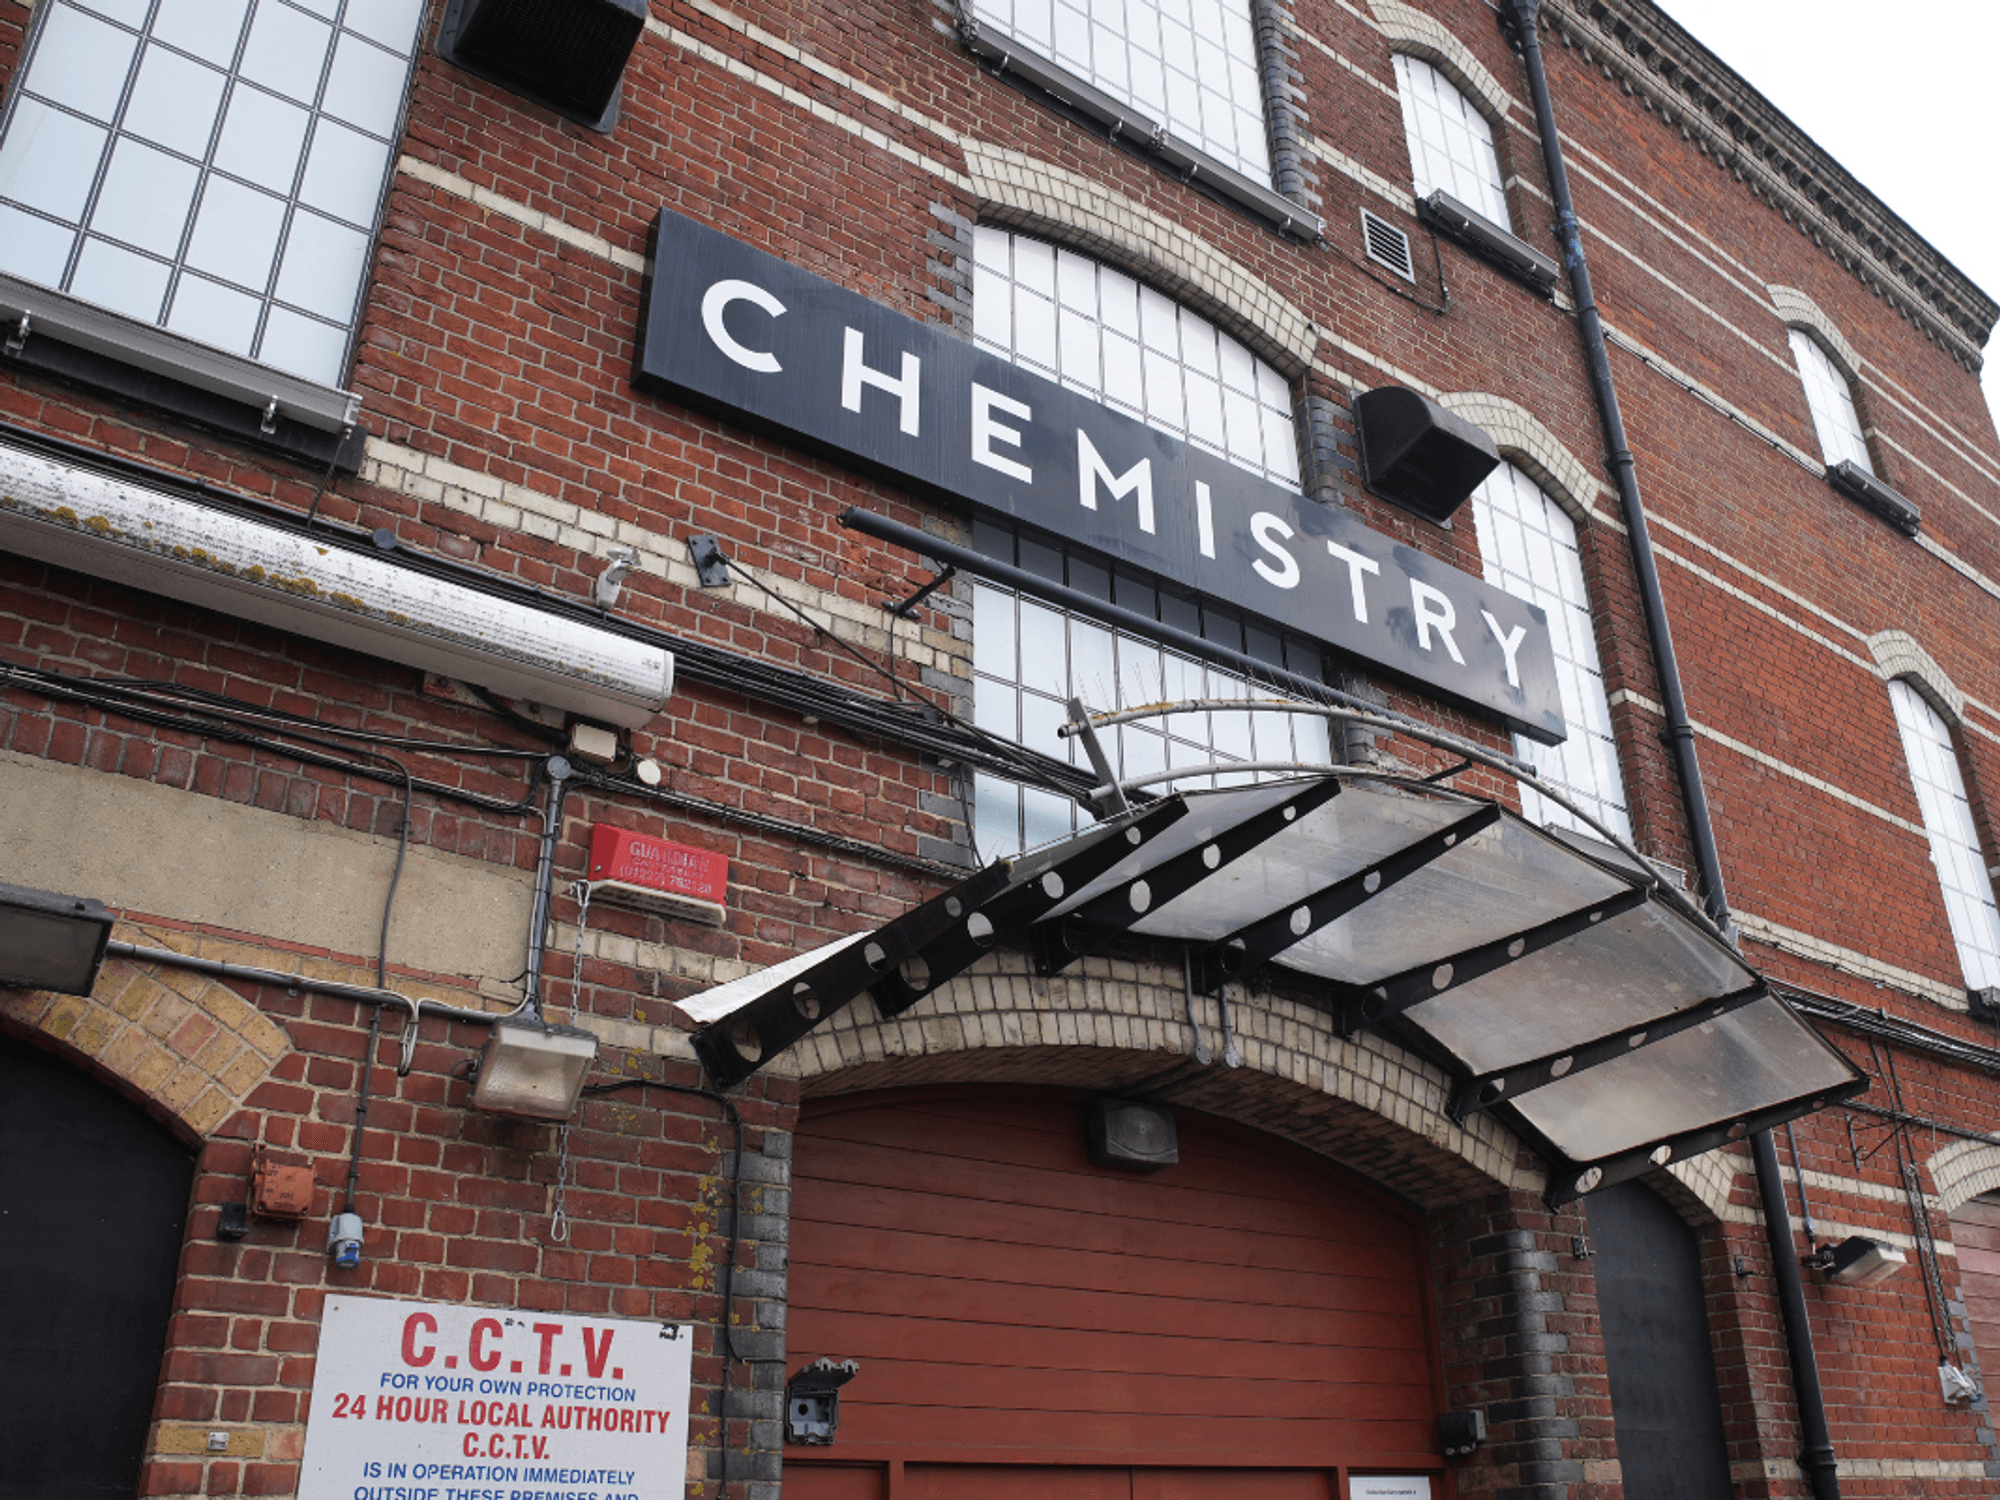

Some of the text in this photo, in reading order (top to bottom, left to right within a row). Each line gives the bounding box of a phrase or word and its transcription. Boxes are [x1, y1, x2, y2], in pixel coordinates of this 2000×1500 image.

[701, 279, 1527, 689] CHEMISTRY
[401, 1312, 624, 1380] C.C.T.V.
[380, 1372, 636, 1402] FOR YOUR OWN PROTECTION
[332, 1392, 670, 1433] 24 HOUR LOCAL AUTHORITY
[462, 1432, 550, 1459] C.C.T.V.
[363, 1462, 635, 1485] IS IN OPERATION IMMEDIATELY
[354, 1486, 439, 1500] OUTSIDE
[446, 1488, 505, 1500] THESE
